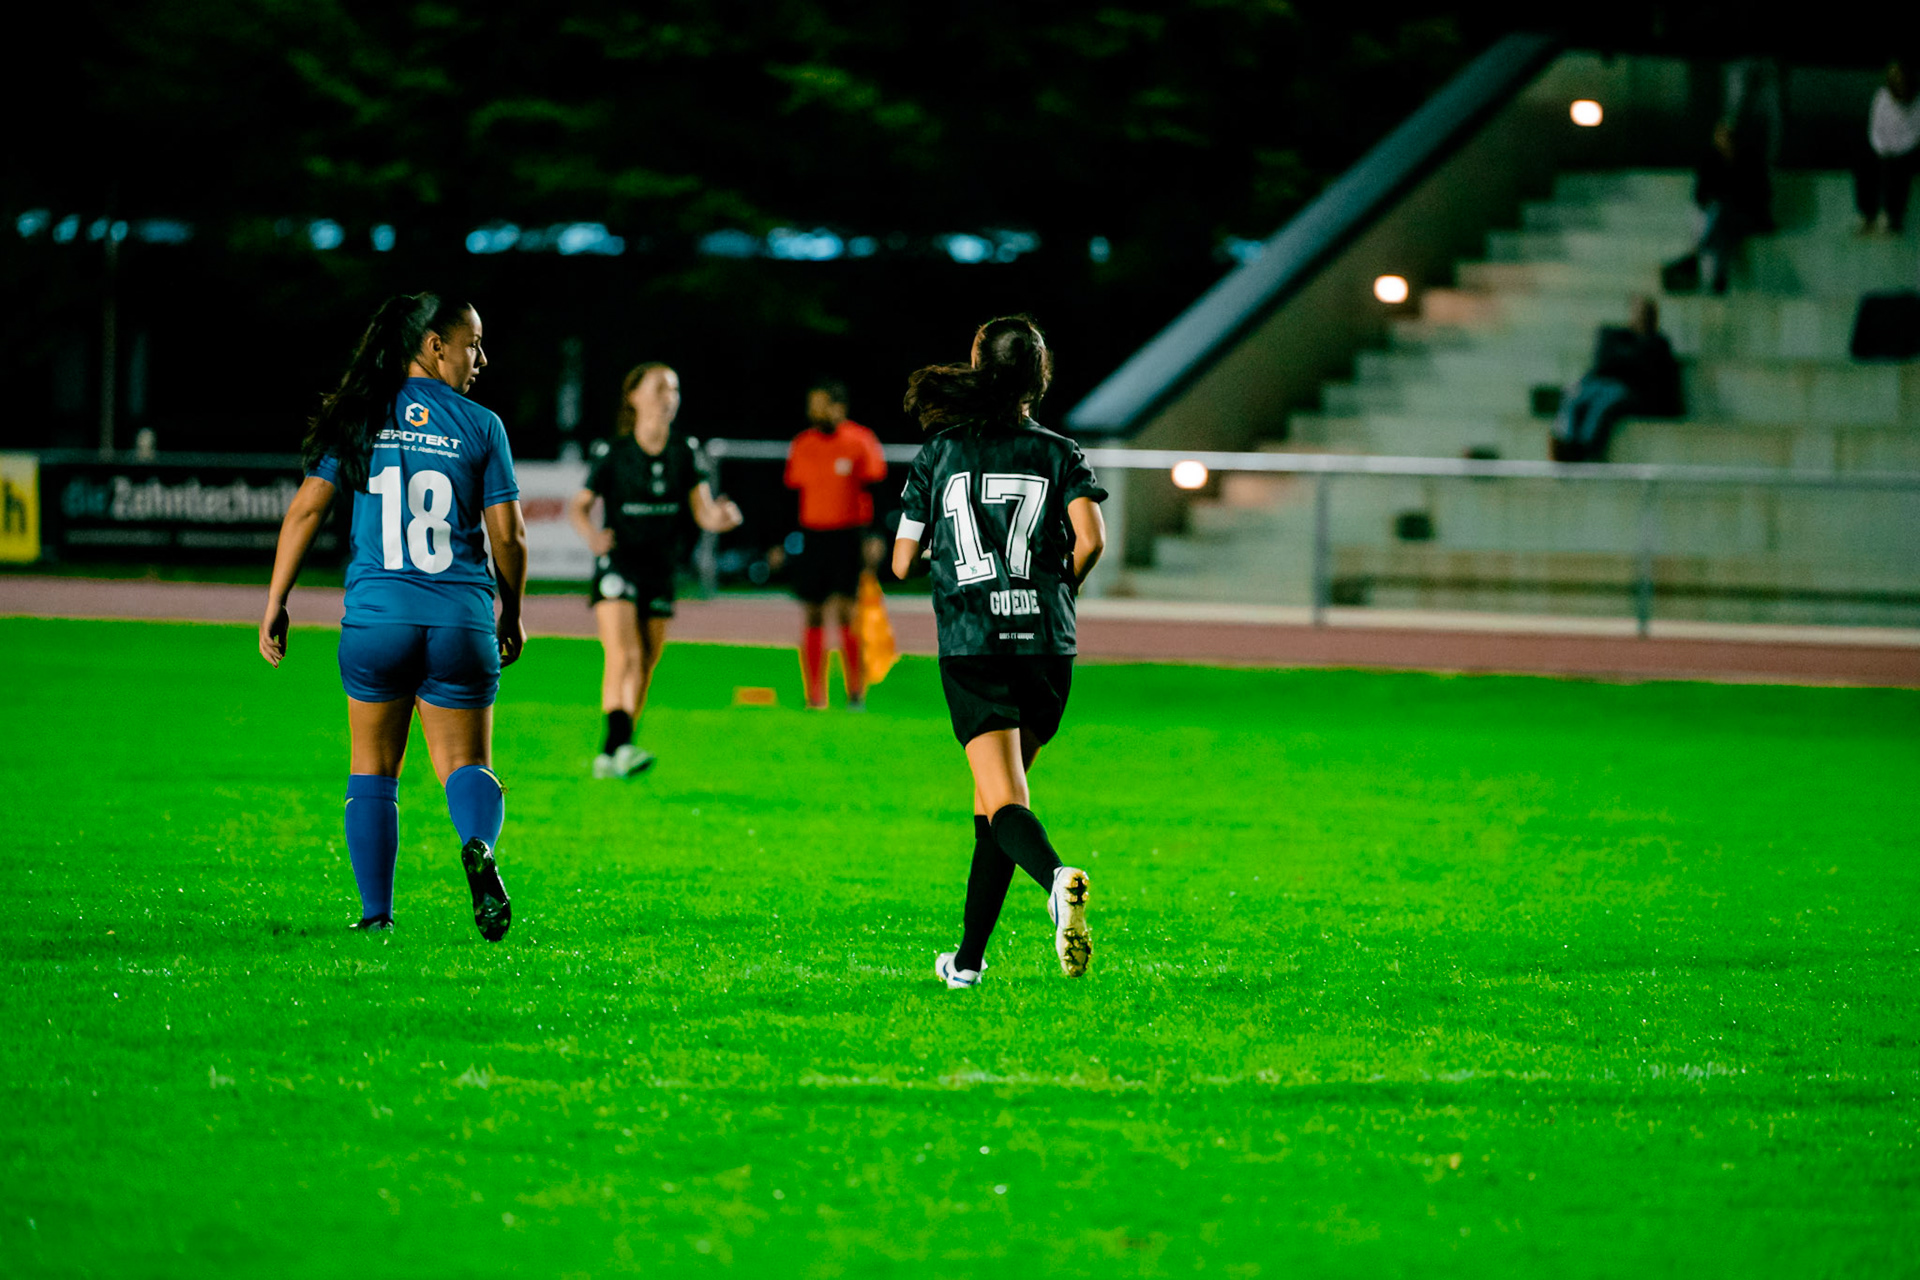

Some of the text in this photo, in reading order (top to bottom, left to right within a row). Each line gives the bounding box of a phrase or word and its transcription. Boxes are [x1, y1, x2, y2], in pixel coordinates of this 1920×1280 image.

[376, 429, 461, 449] EROTEKT
[369, 466, 453, 574] 18
[943, 471, 1049, 586] 17
[990, 589, 1040, 616] GUEDE
